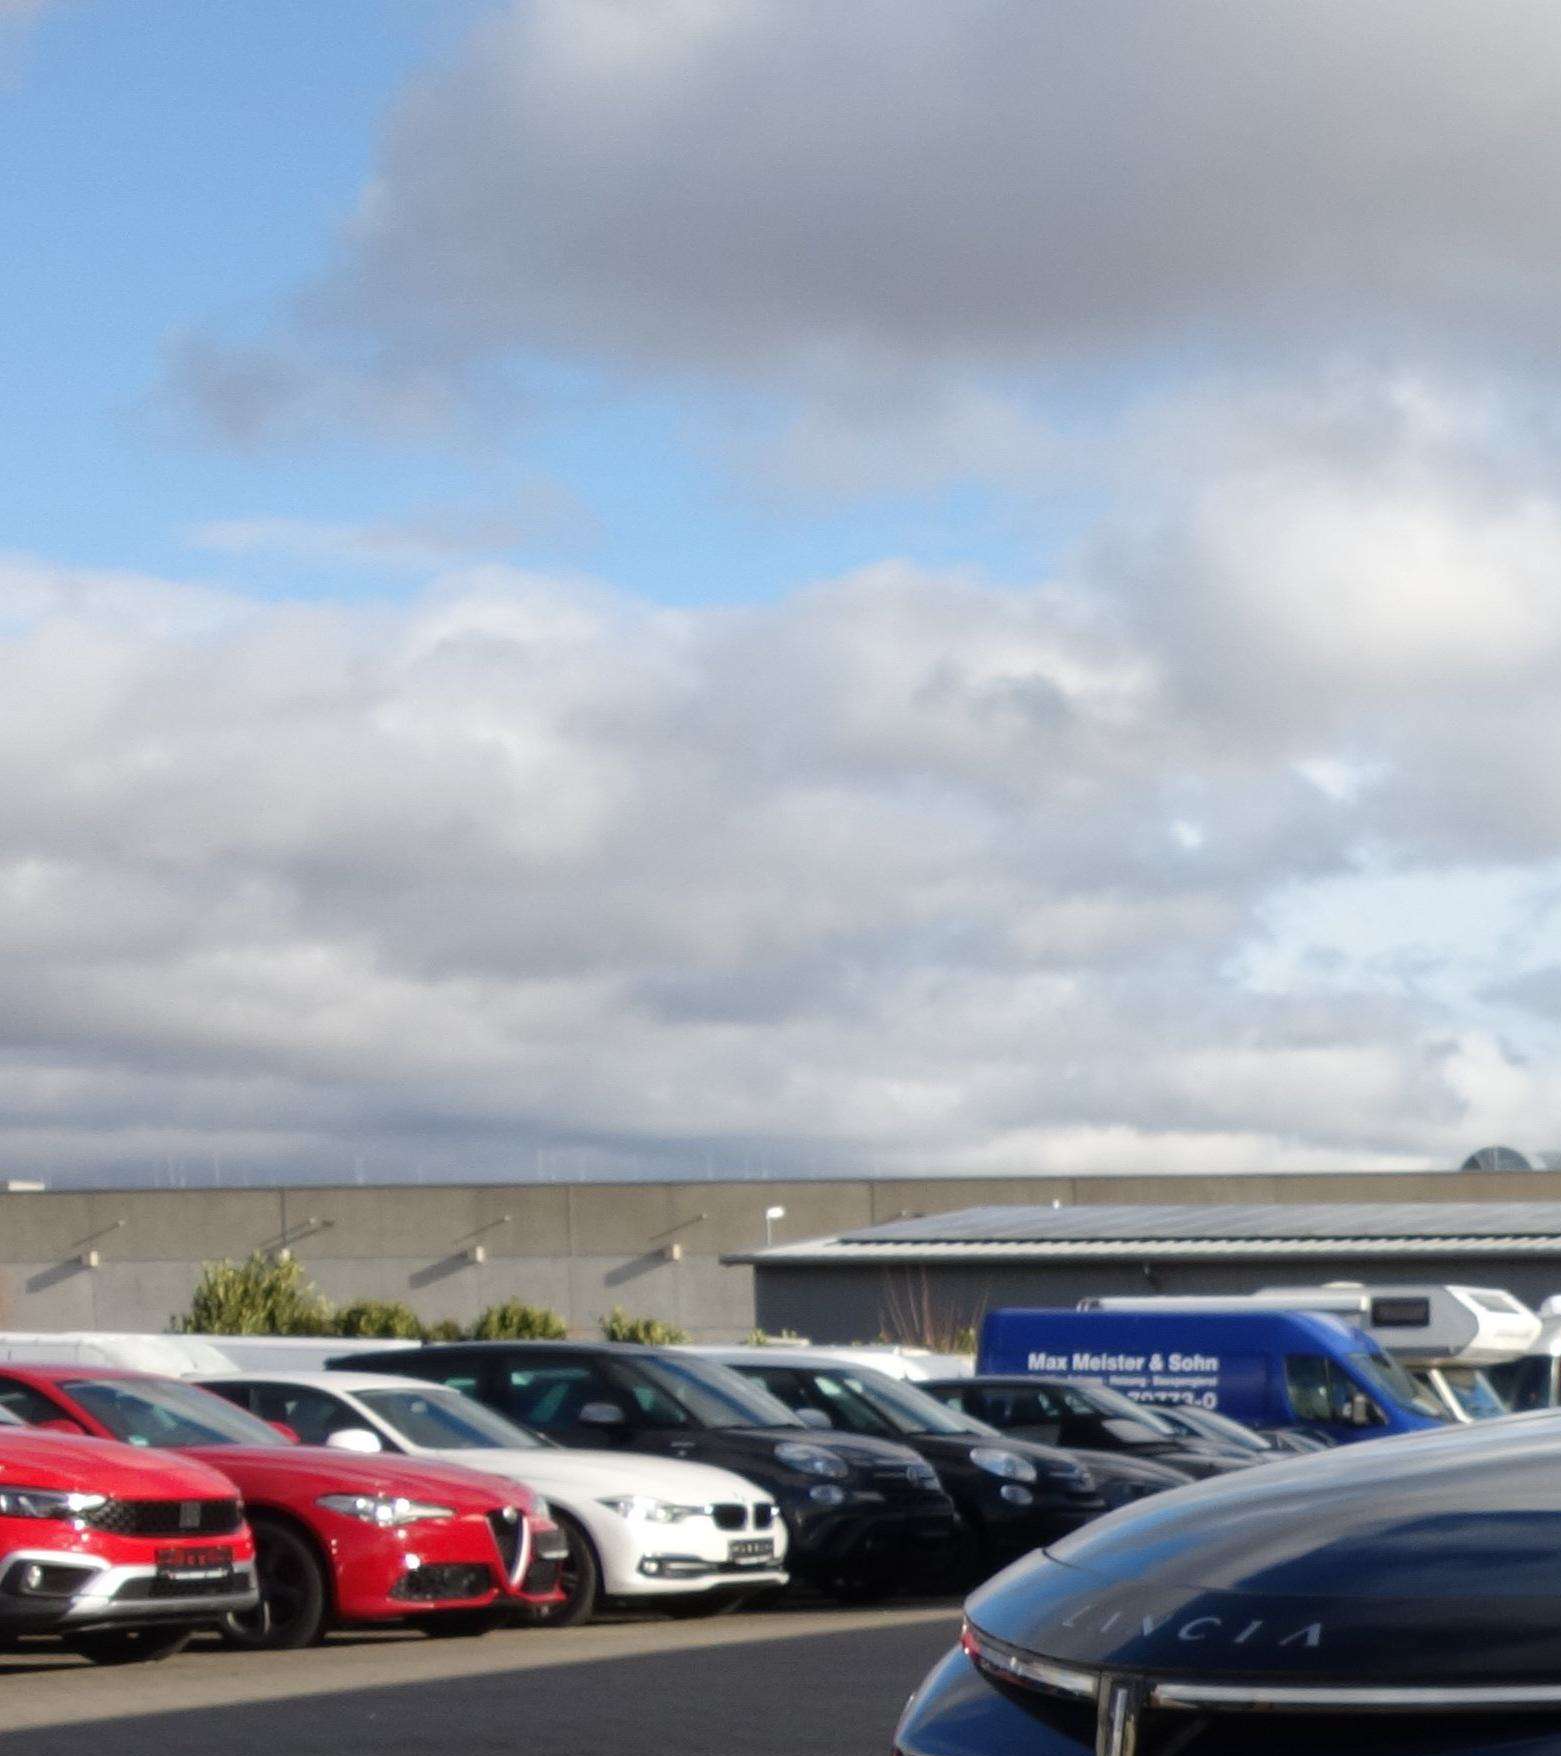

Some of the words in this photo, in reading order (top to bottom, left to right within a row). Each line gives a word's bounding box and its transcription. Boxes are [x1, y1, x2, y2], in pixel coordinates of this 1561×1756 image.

[1027, 1352, 1068, 1371] Max
[1072, 1352, 1146, 1371] Meister
[1149, 1352, 1164, 1371] &
[1168, 1352, 1219, 1371] Sohn
